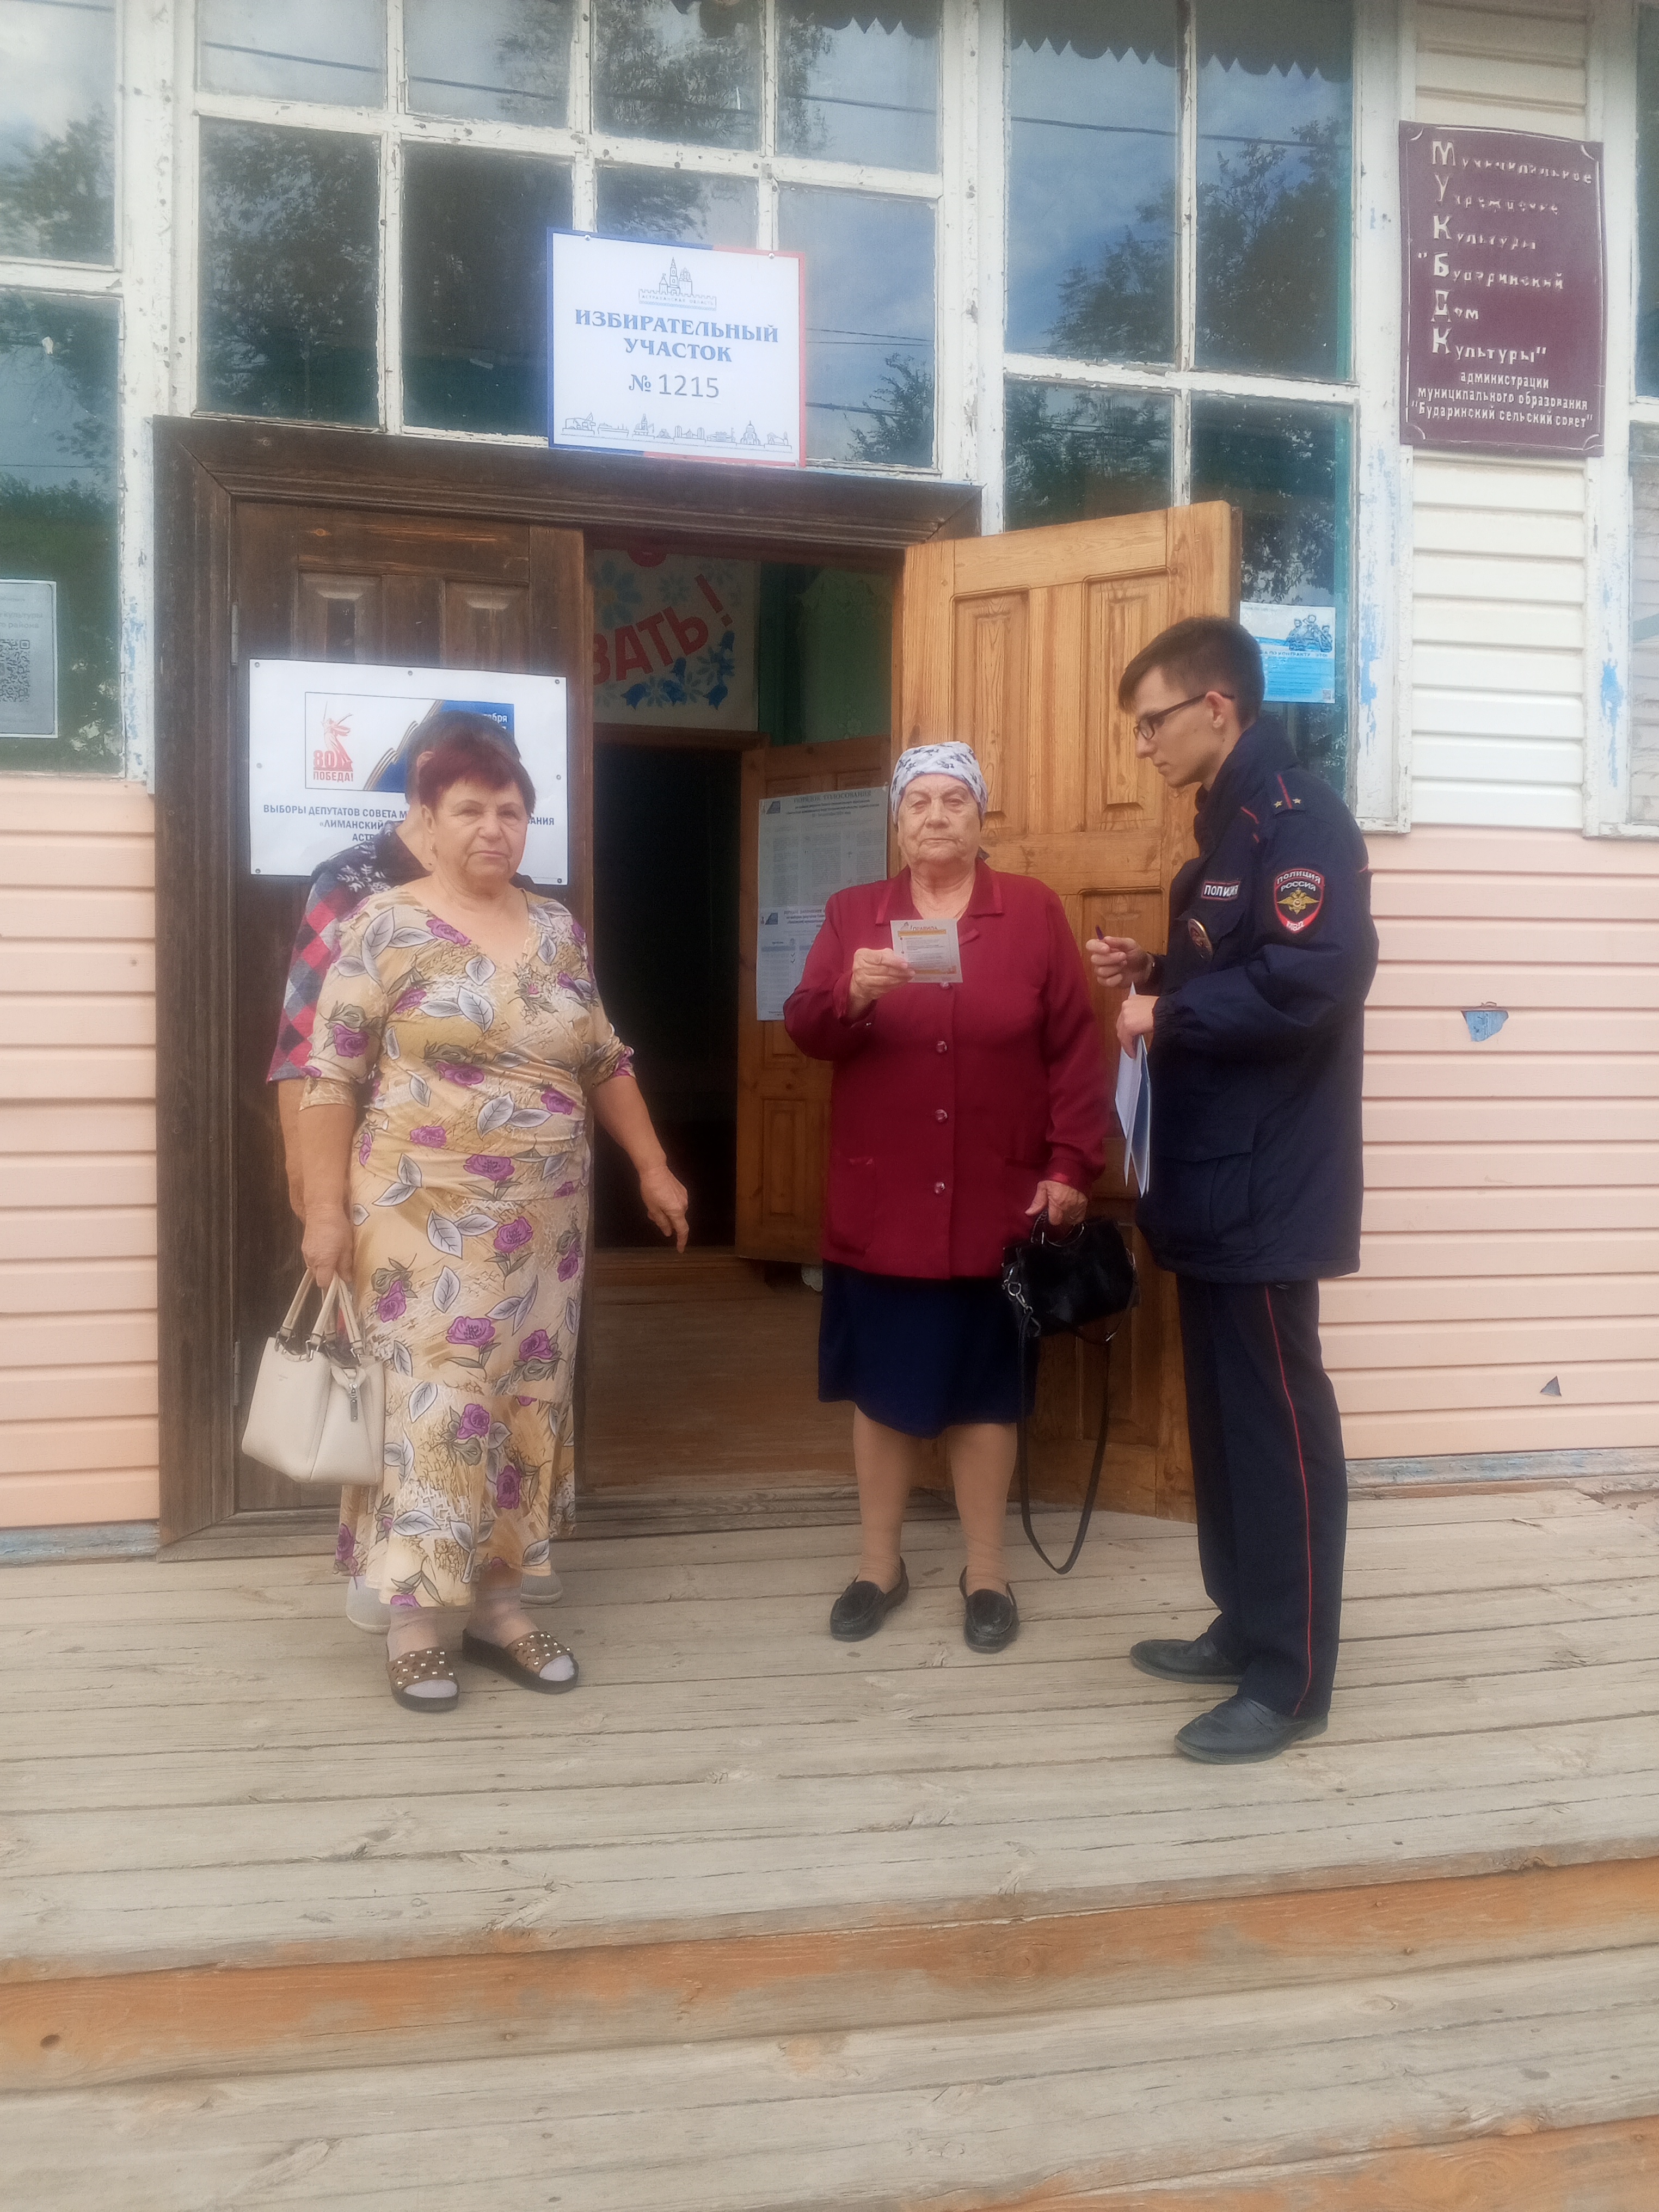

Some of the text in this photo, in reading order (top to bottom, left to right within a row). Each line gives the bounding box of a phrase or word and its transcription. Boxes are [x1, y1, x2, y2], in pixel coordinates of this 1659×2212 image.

[1433, 215, 1537, 250] Культуры
[1430, 289, 1480, 323] Дом
[574, 309, 779, 343] ИЗБИРАТЕЛЬНЫЙ
[623, 338, 733, 362] УЧАСТОК
[1431, 327, 1547, 365] Культуры"
[628, 374, 720, 398] № 1215
[1460, 371, 1550, 390] администрации
[1417, 386, 1588, 411] муниципального образования
[1411, 401, 1594, 428] "Бударинский сельский совет"
[313, 771, 353, 783] ПОБЕДА!
[263, 804, 306, 814] ВЫБОРЫ
[309, 806, 360, 816] ДЕПУТАТОВ
[362, 809, 397, 818] СОВЕТА
[1277, 871, 1321, 884] ПОЛИЦИЯ
[1281, 881, 1316, 892] РОССИЯ
